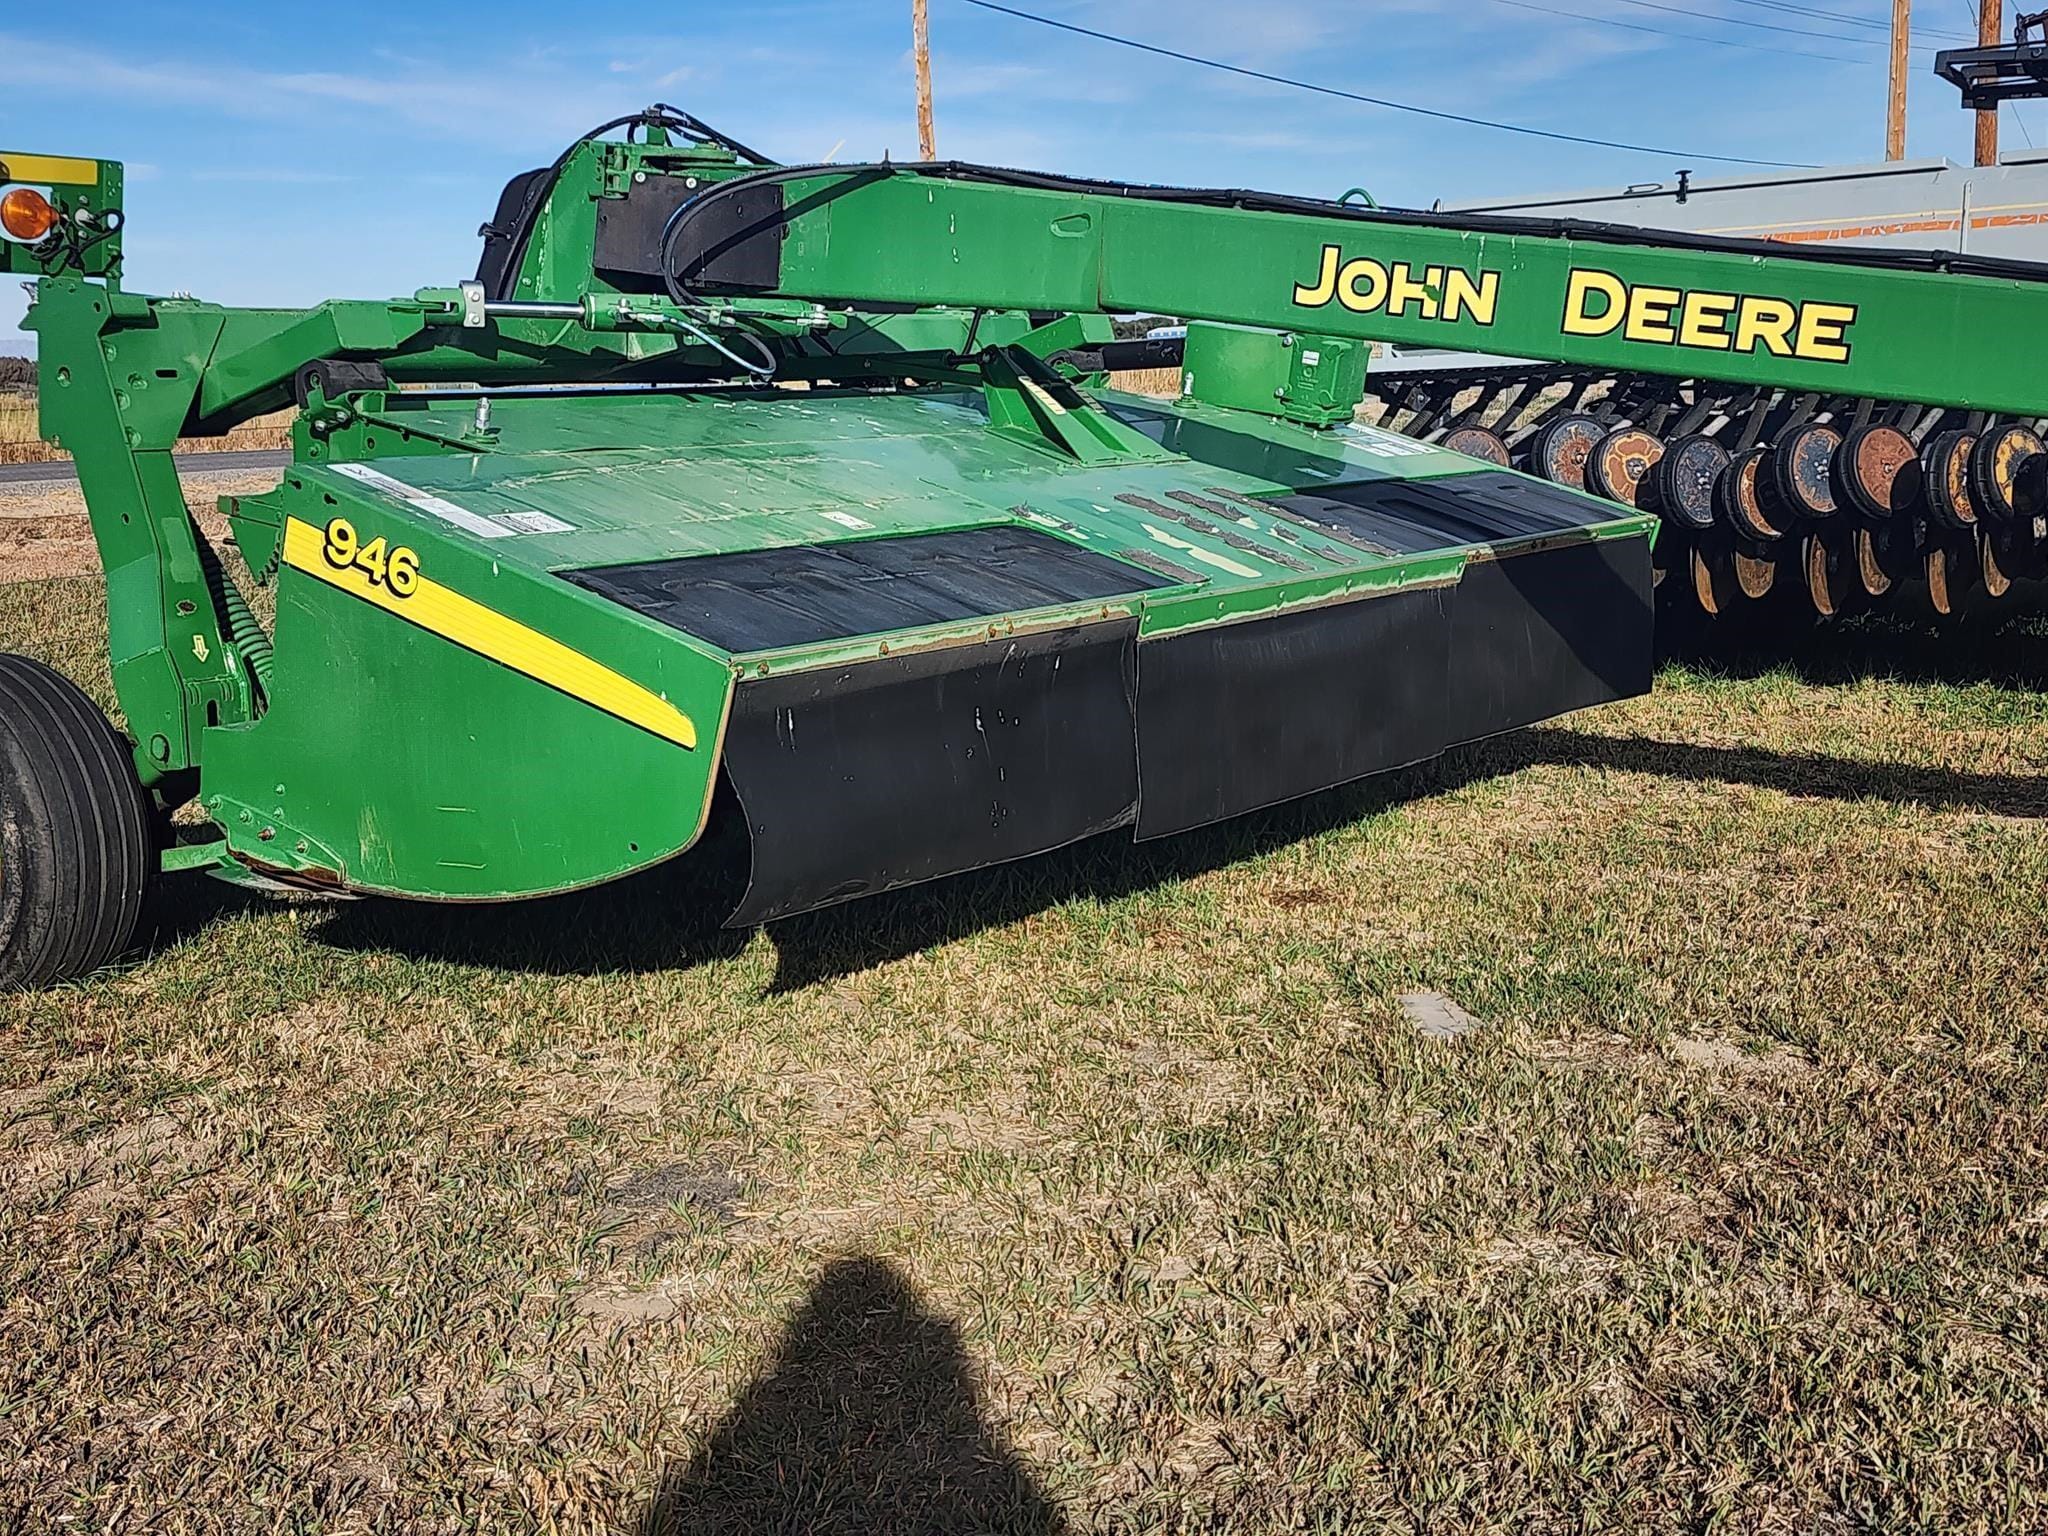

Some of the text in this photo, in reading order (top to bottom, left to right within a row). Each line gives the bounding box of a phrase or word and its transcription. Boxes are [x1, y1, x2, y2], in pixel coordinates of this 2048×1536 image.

[1293, 245, 1857, 363] JOHN DEERE
[323, 519, 419, 598] 946
